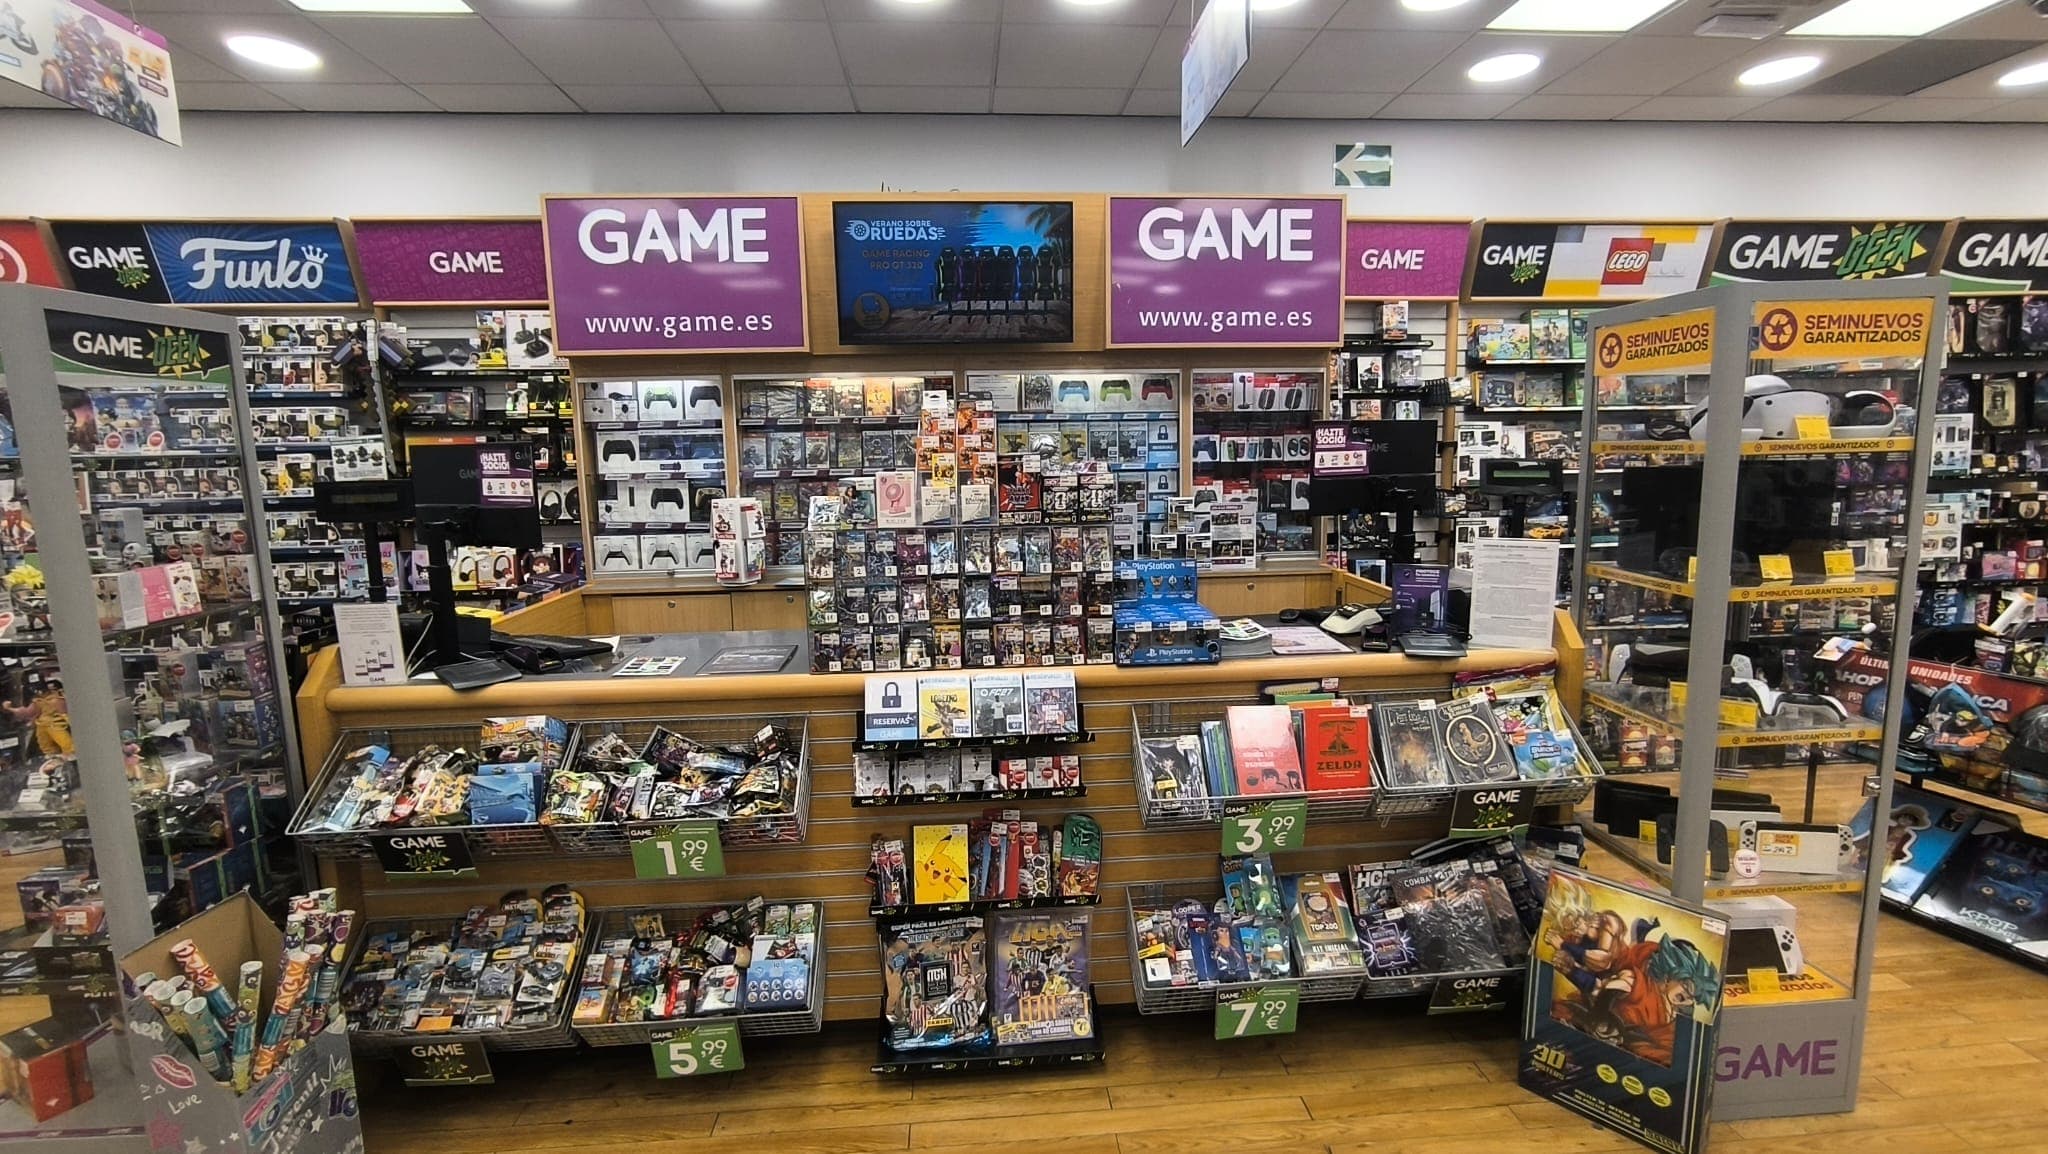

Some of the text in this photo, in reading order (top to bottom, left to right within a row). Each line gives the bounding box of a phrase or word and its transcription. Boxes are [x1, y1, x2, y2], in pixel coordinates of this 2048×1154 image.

[578, 208, 769, 264] GAME
[871, 227, 938, 241] RUEDAS
[1138, 208, 1314, 262] GAME
[68, 246, 149, 269] GAME
[1361, 248, 1425, 270] GAME
[1483, 245, 1546, 265] GAME
[1729, 223, 1924, 277] GAME GEEK
[1958, 233, 2048, 267] GAME
[180, 237, 325, 290] Funko
[429, 251, 503, 274] GAME
[1607, 248, 1648, 272] LEGO
[585, 311, 773, 338] www.game.es
[1139, 309, 1313, 332] www.game.es
[1804, 312, 1924, 331] SEMINUEVOS
[1626, 323, 1710, 347] SEMINUEVOS
[1803, 328, 1921, 344] GARANTIZADOS
[72, 331, 201, 367] GAME GEEK
[1625, 341, 1709, 361] GARANTIZADOS
[1768, 441, 1880, 451] SEMINUEVOS GARANTIZADOS
[1132, 562, 1175, 572] PlayStation
[1755, 587, 1864, 598] SEMINUEVOS GARANTIZADOS
[1910, 666, 1973, 685] UNIDADES
[1746, 731, 1852, 743] SEMINUEVOS GARANTIZADOS
[1317, 760, 1362, 771] ZELDA
[1473, 789, 1521, 805] GAME
[1225, 806, 1248, 814] GAME
[631, 829, 653, 837] GAME
[1273, 832, 1287, 847] €
[390, 836, 447, 850] GAME
[689, 857, 704, 871] €
[1959, 907, 2019, 930] KPOP
[1009, 922, 1073, 943] LIGA
[1453, 977, 1501, 989] GAME
[1220, 992, 1239, 1000] GAME
[1266, 1015, 1279, 1030] €
[652, 1032, 673, 1040] GAME
[411, 1043, 465, 1058] GAME
[710, 1054, 724, 1068] €
[1714, 1039, 1838, 1082] GAME
[168, 1094, 202, 1115] Love
